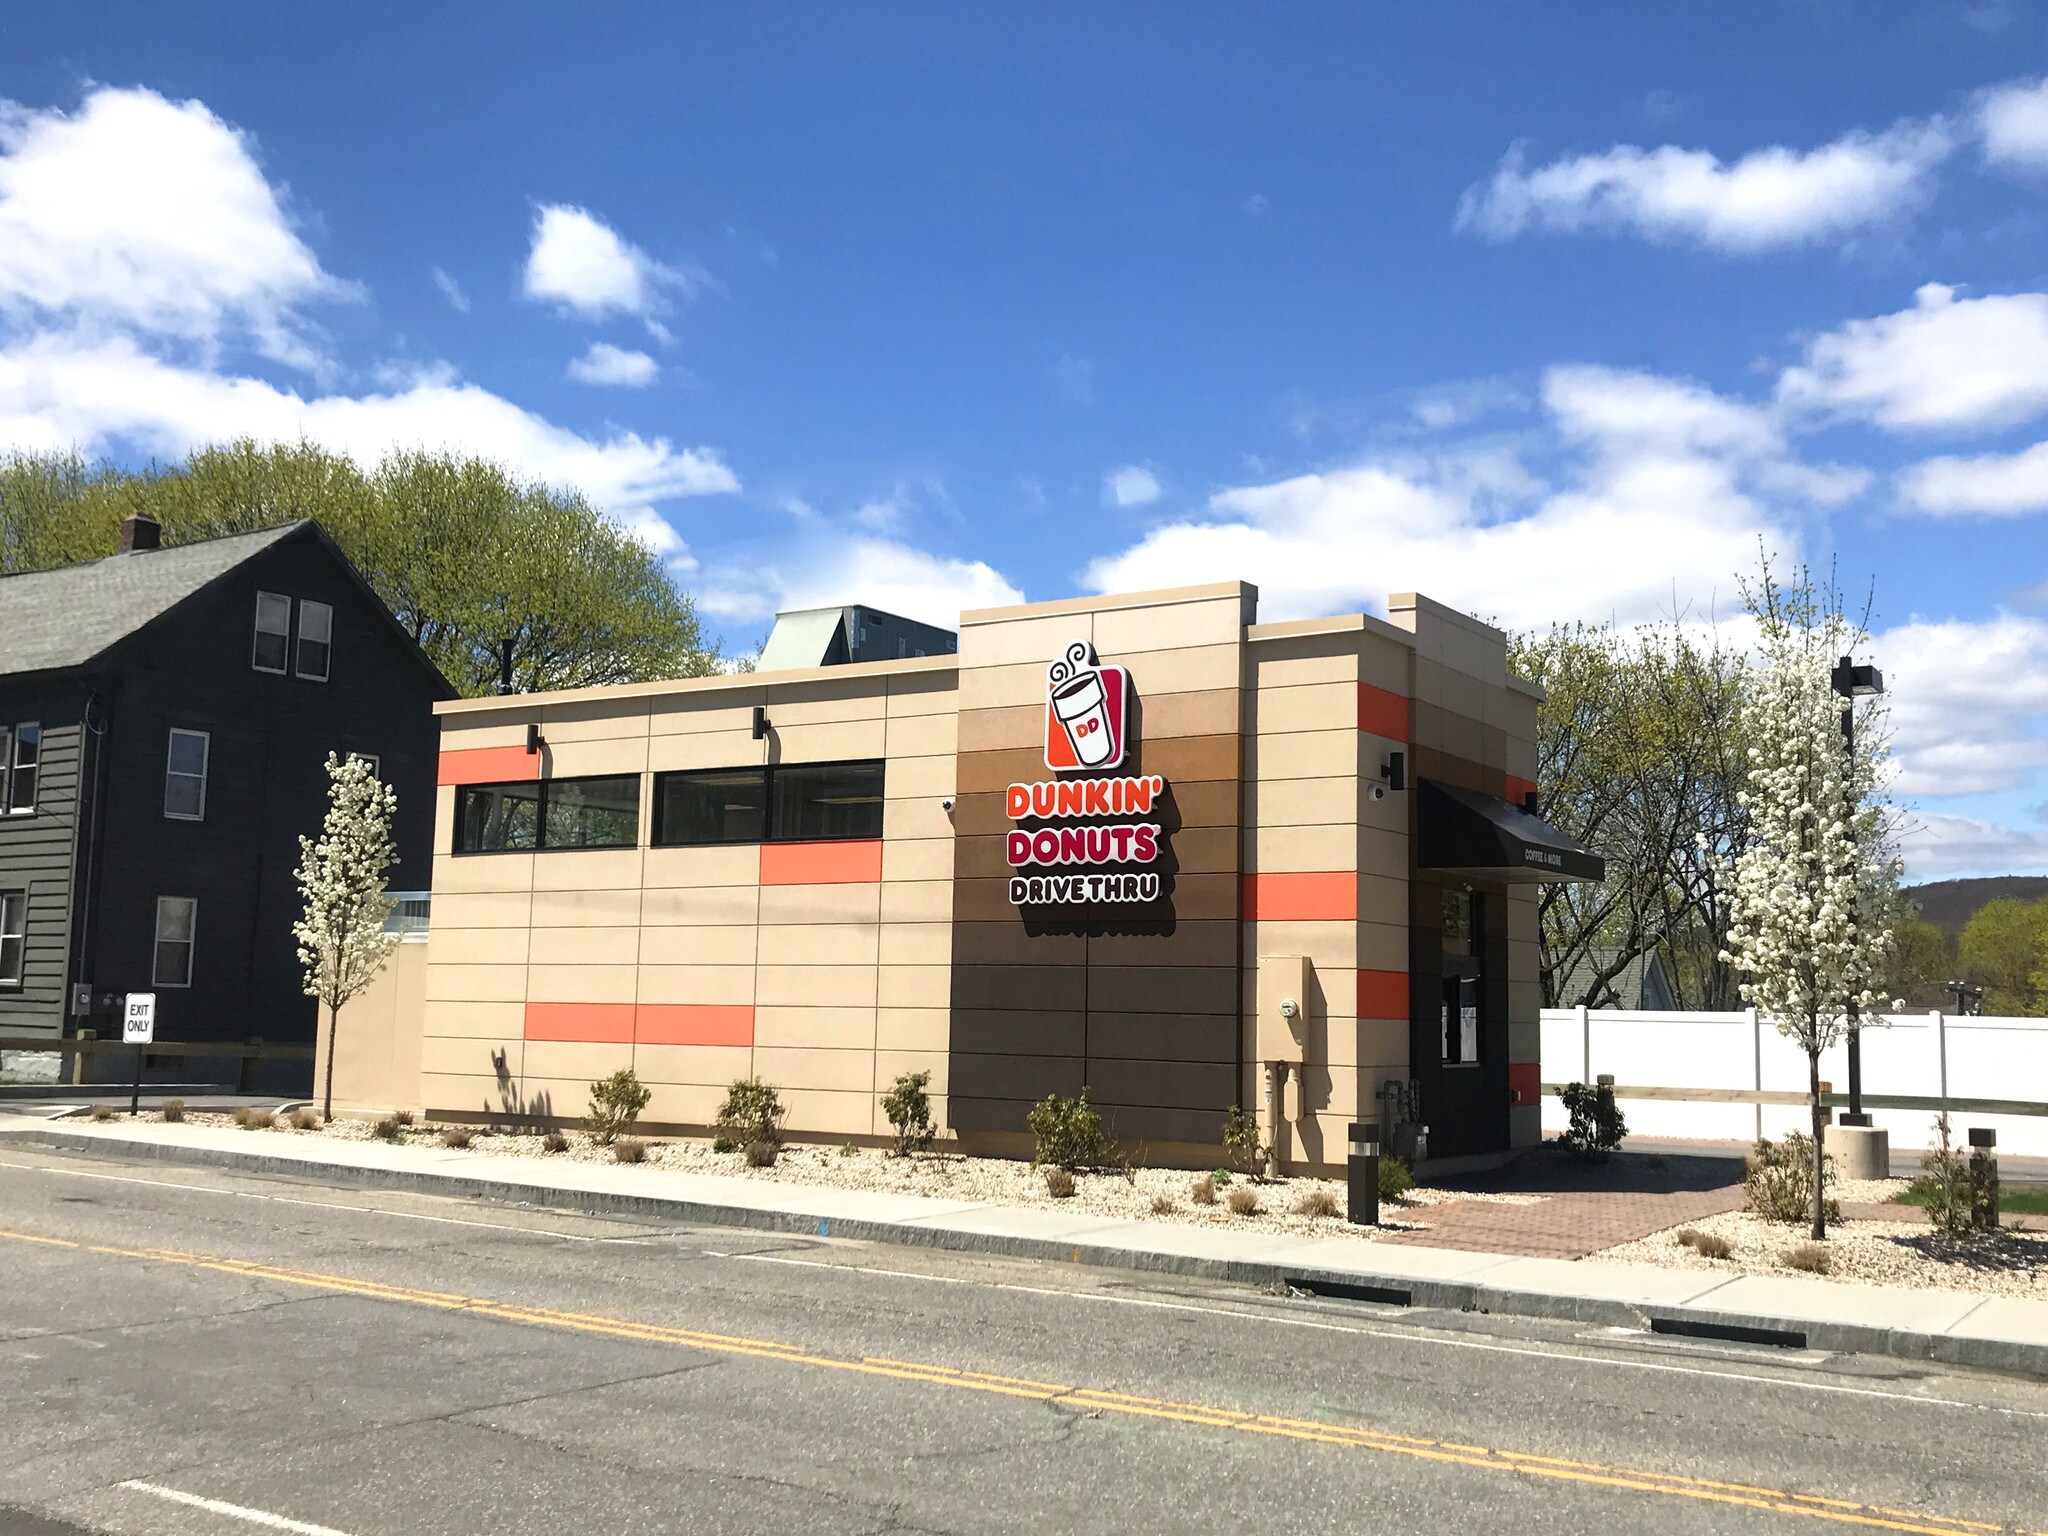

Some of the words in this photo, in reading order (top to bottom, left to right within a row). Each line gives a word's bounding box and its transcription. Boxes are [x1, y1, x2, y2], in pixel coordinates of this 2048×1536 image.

[1075, 717, 1099, 738] DD
[1007, 777, 1161, 817] DUNKIN'
[1008, 826, 1157, 864] DONUTS
[1524, 848, 1544, 863] COFFEE
[1547, 853, 1562, 867] MORE
[130, 1004, 150, 1016] EXIT
[127, 1019, 150, 1032] ONLY
